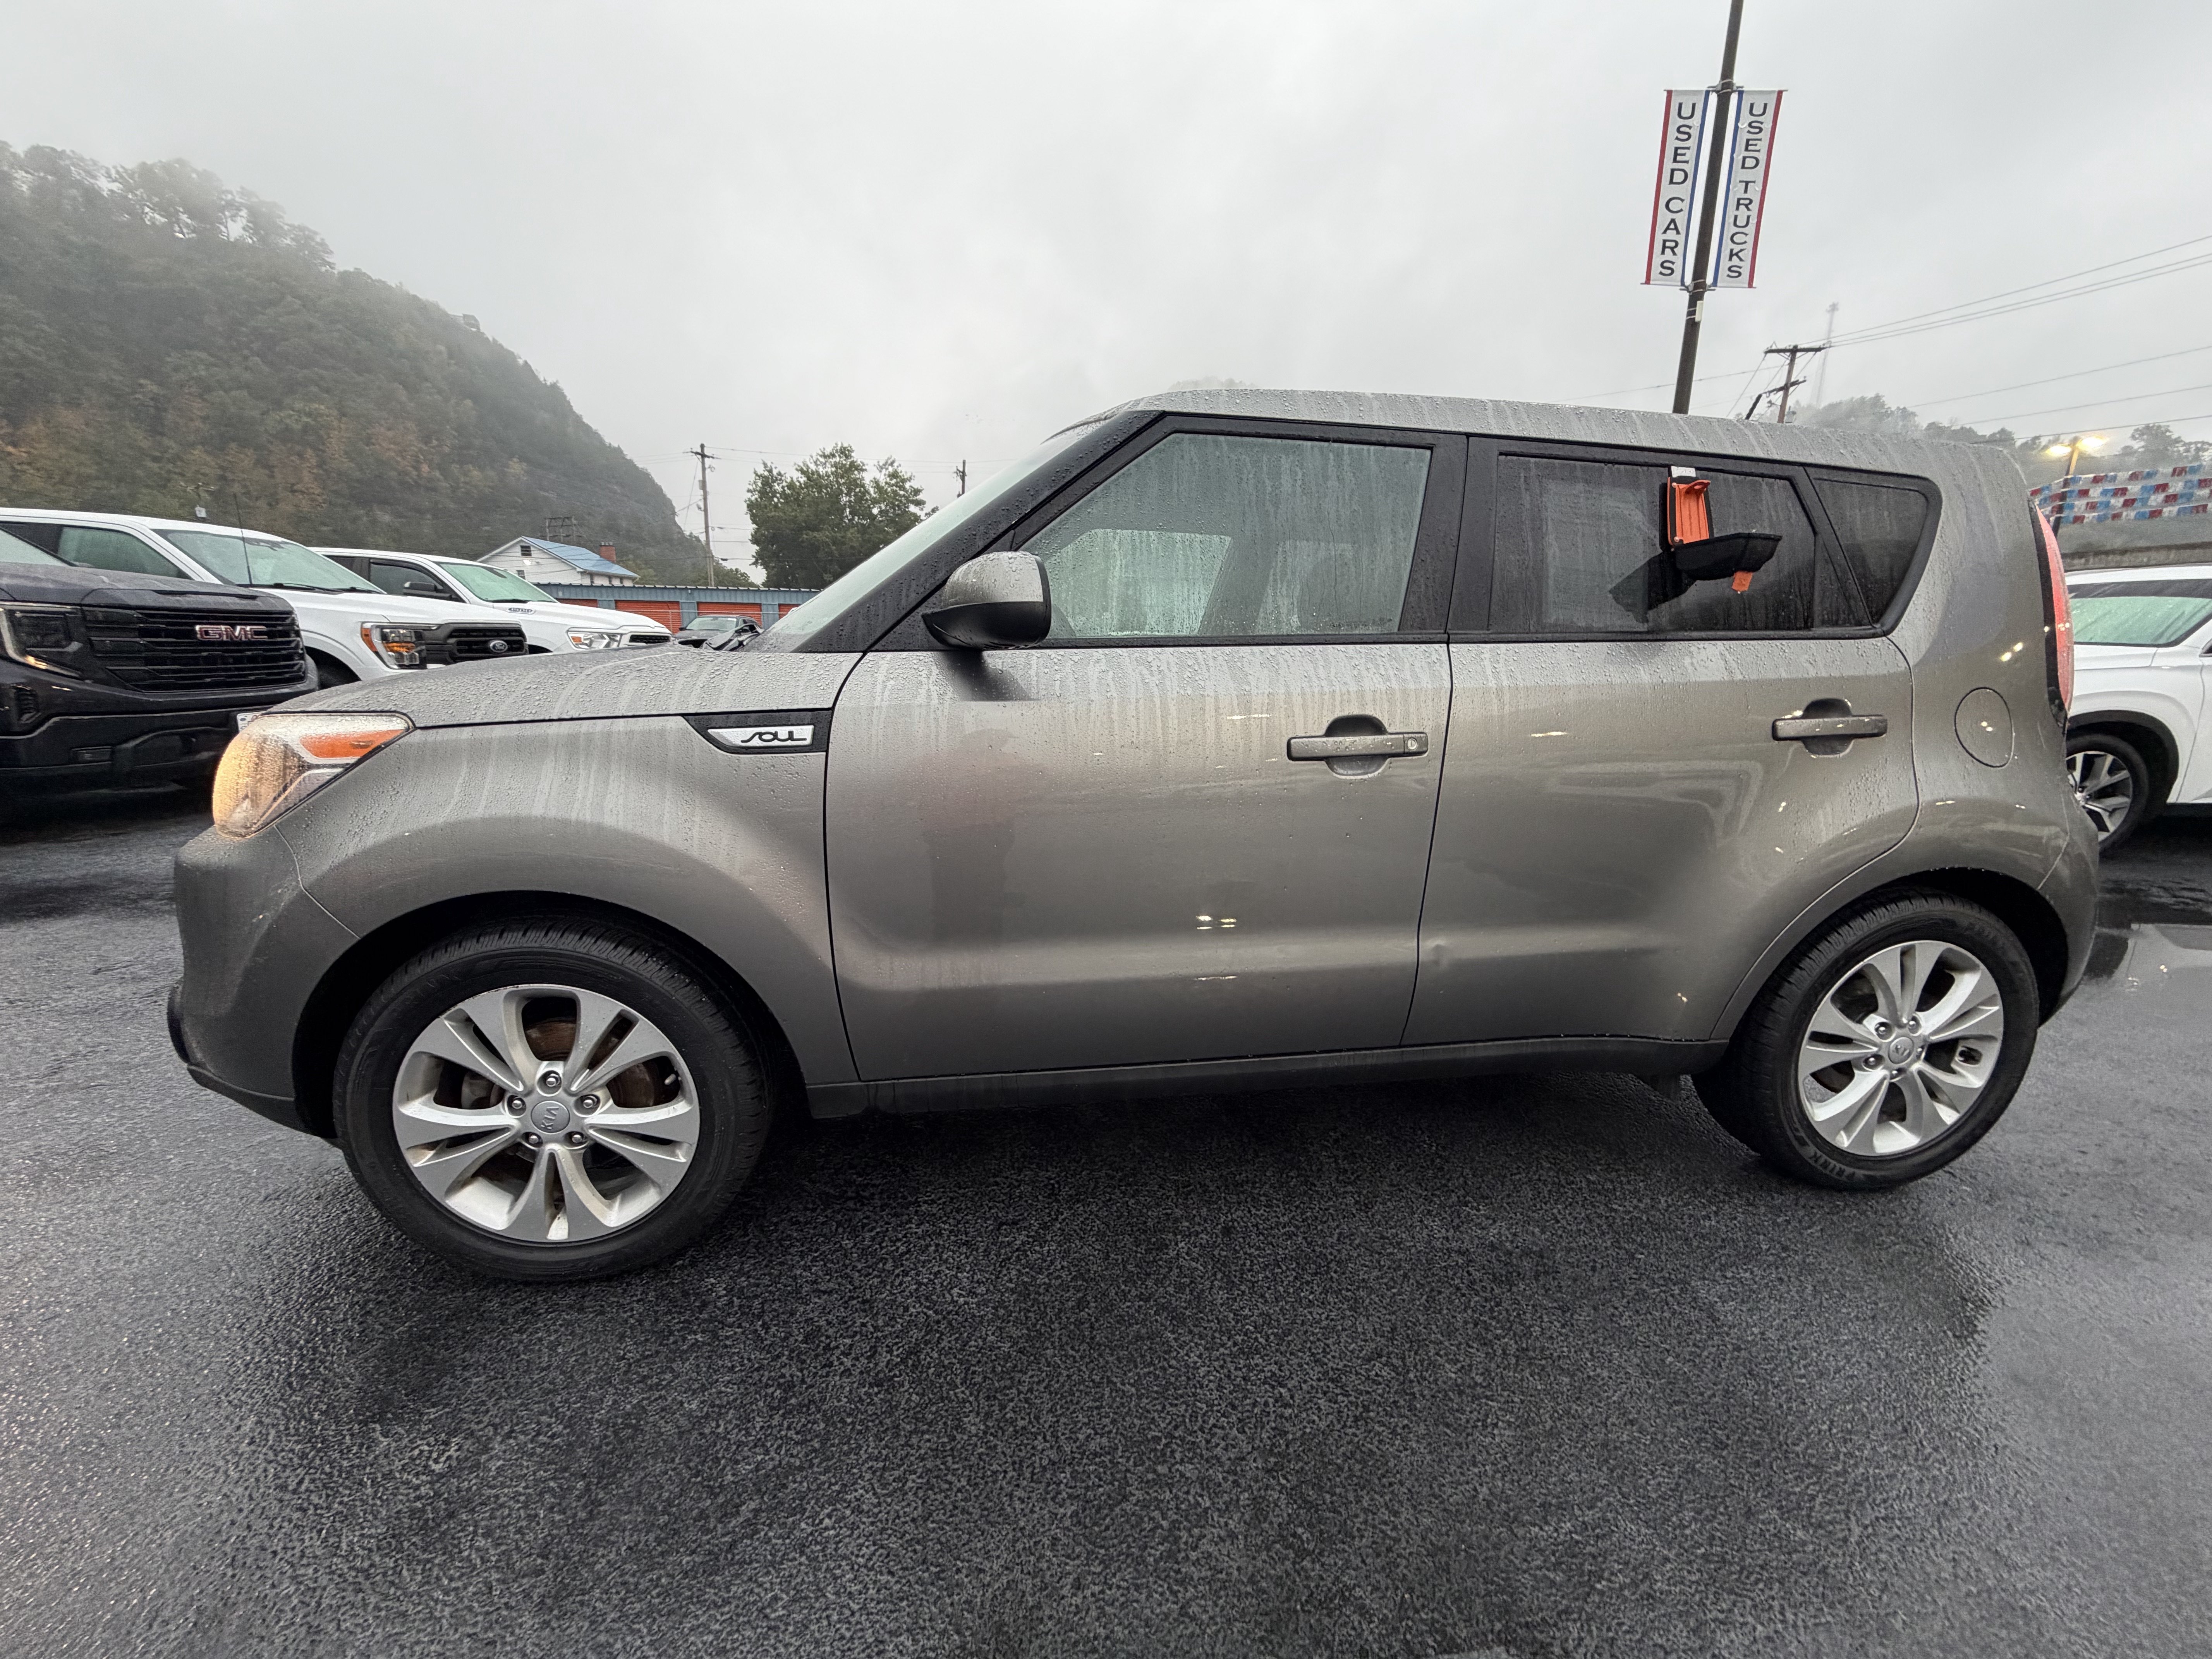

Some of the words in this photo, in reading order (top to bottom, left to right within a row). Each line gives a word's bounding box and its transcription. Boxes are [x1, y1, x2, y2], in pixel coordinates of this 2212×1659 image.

[1669, 102, 1696, 185] USED
[1740, 103, 1767, 170] USED
[1659, 197, 1685, 276] CARS
[1726, 180, 1756, 278] TRUCKS
[196, 625, 267, 641] GMC
[741, 730, 807, 743] SOUL
[541, 1106, 559, 1130] KIA
